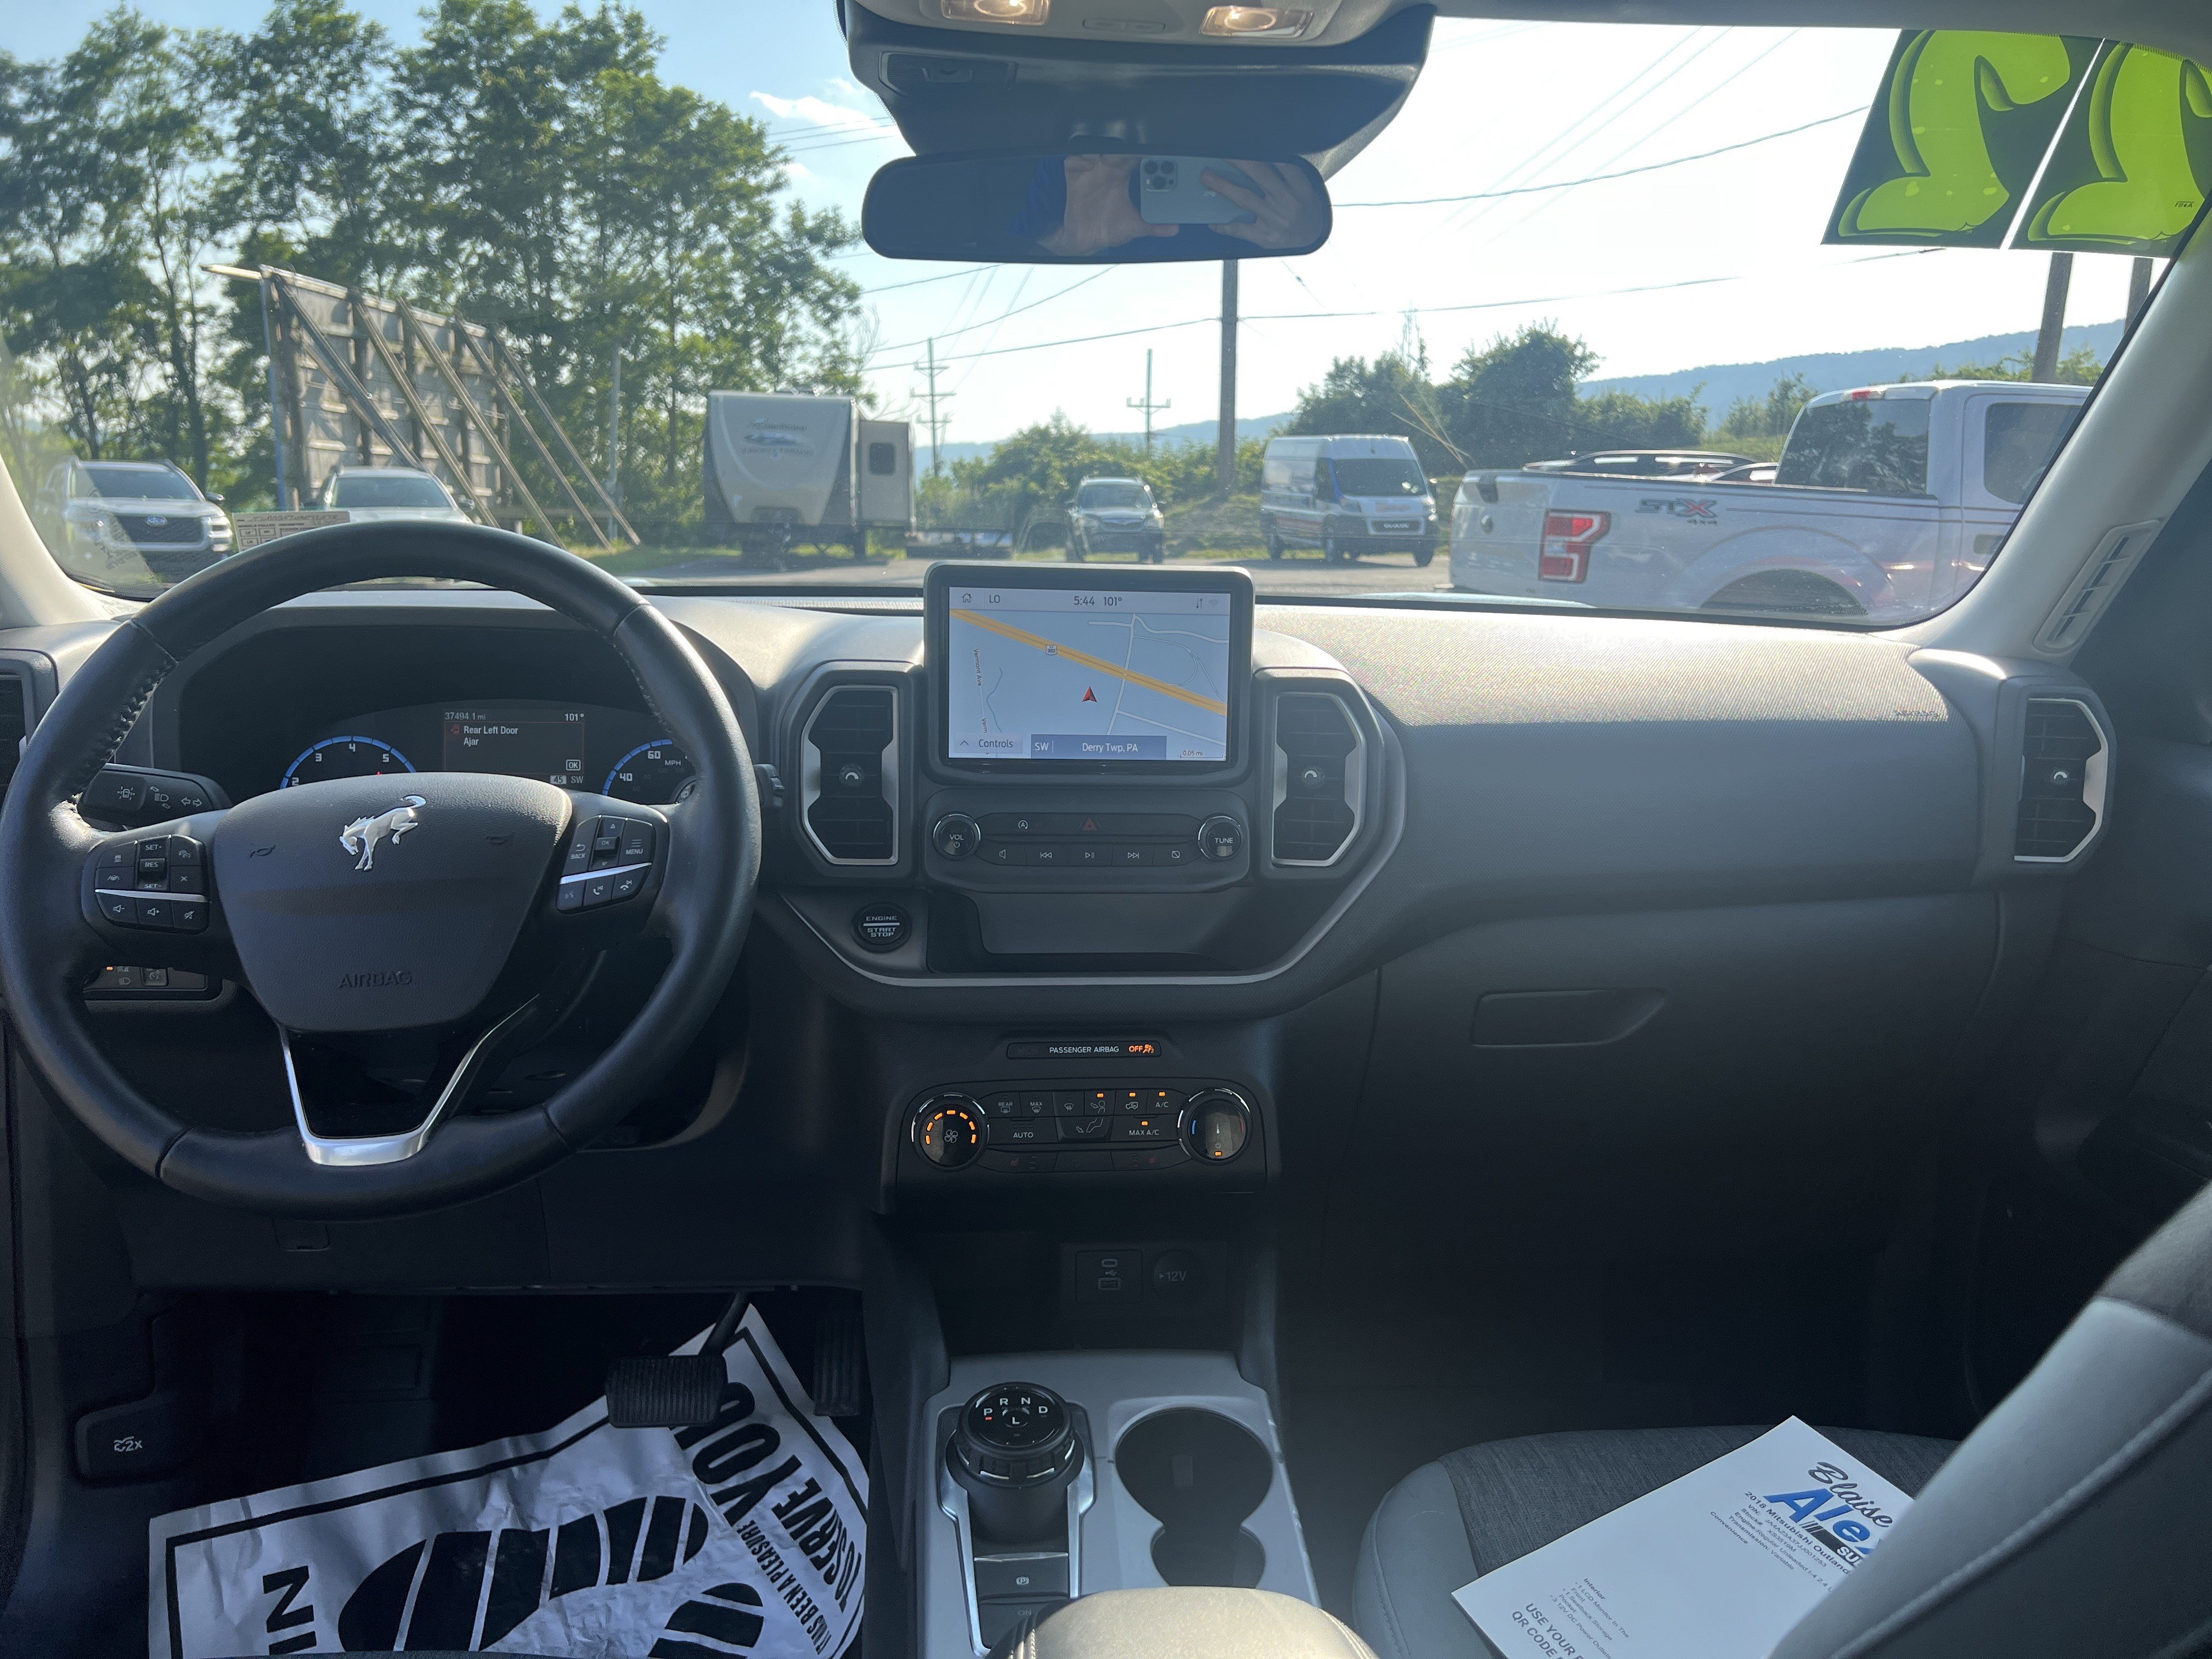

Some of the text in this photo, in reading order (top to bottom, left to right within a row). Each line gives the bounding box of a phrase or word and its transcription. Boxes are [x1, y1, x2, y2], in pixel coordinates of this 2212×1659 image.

[1635, 498, 1718, 518] STX
[989, 595, 1001, 603] LO
[1074, 596, 1122, 606] 5:44 101°
[463, 725, 518, 735] Rear Left Door
[349, 743, 356, 752] 4
[463, 737, 479, 747] Ajar
[979, 739, 1013, 748] Controls
[1035, 742, 1049, 751] SW
[1082, 743, 1104, 753] Derry
[1126, 743, 1138, 752] PA
[315, 753, 323, 762] 3
[382, 754, 390, 763] 5
[647, 750, 661, 759] 60
[292, 777, 300, 786] 2
[571, 776, 584, 784] SW
[619, 772, 633, 782] 40
[339, 970, 412, 988] AIRBAG
[1155, 1101, 1169, 1109] A/C
[1146, 1128, 1160, 1136] A/C
[1165, 1271, 1187, 1282] 12V
[1011, 1417, 1020, 1425] L
[1808, 1462, 1893, 1527] Blaise
[1741, 1508, 1763, 1525] Stock#
[1748, 1504, 1761, 1516] VIN:
[1744, 1491, 1767, 1509] 2018
[1766, 1509, 1814, 1545] Mitsubishi
[1710, 1511, 1748, 1544] Convenience
[771, 1476, 862, 1614] TO SERVE
[1728, 1515, 1795, 1570] Transmission: Variable
[737, 1519, 789, 1584] PLEASURE
[1837, 1546, 1862, 1566] SU
[1779, 1548, 1808, 1571] Unleaded
[776, 1573, 797, 1593] A
[1583, 1578, 1606, 1600] Interior
[1571, 1588, 1585, 1602] Front
[783, 1583, 820, 1626] BEEN
[1559, 1594, 1577, 1613] Pocket
[1569, 1595, 1593, 1621] Seatback
[1592, 1620, 1612, 1641] Storage
[1581, 1589, 1594, 1601] LCD
[1593, 1601, 1613, 1621] Monitor
[1618, 1626, 1629, 1638] The
[1512, 1611, 1558, 1657] QR CODE
[1525, 1603, 1576, 1656] USE YOUR
[1557, 1602, 1569, 1613] 12V
[1567, 1613, 1578, 1623] DC
[1576, 1622, 1593, 1640] Power
[1593, 1640, 1611, 1659] Outlets
